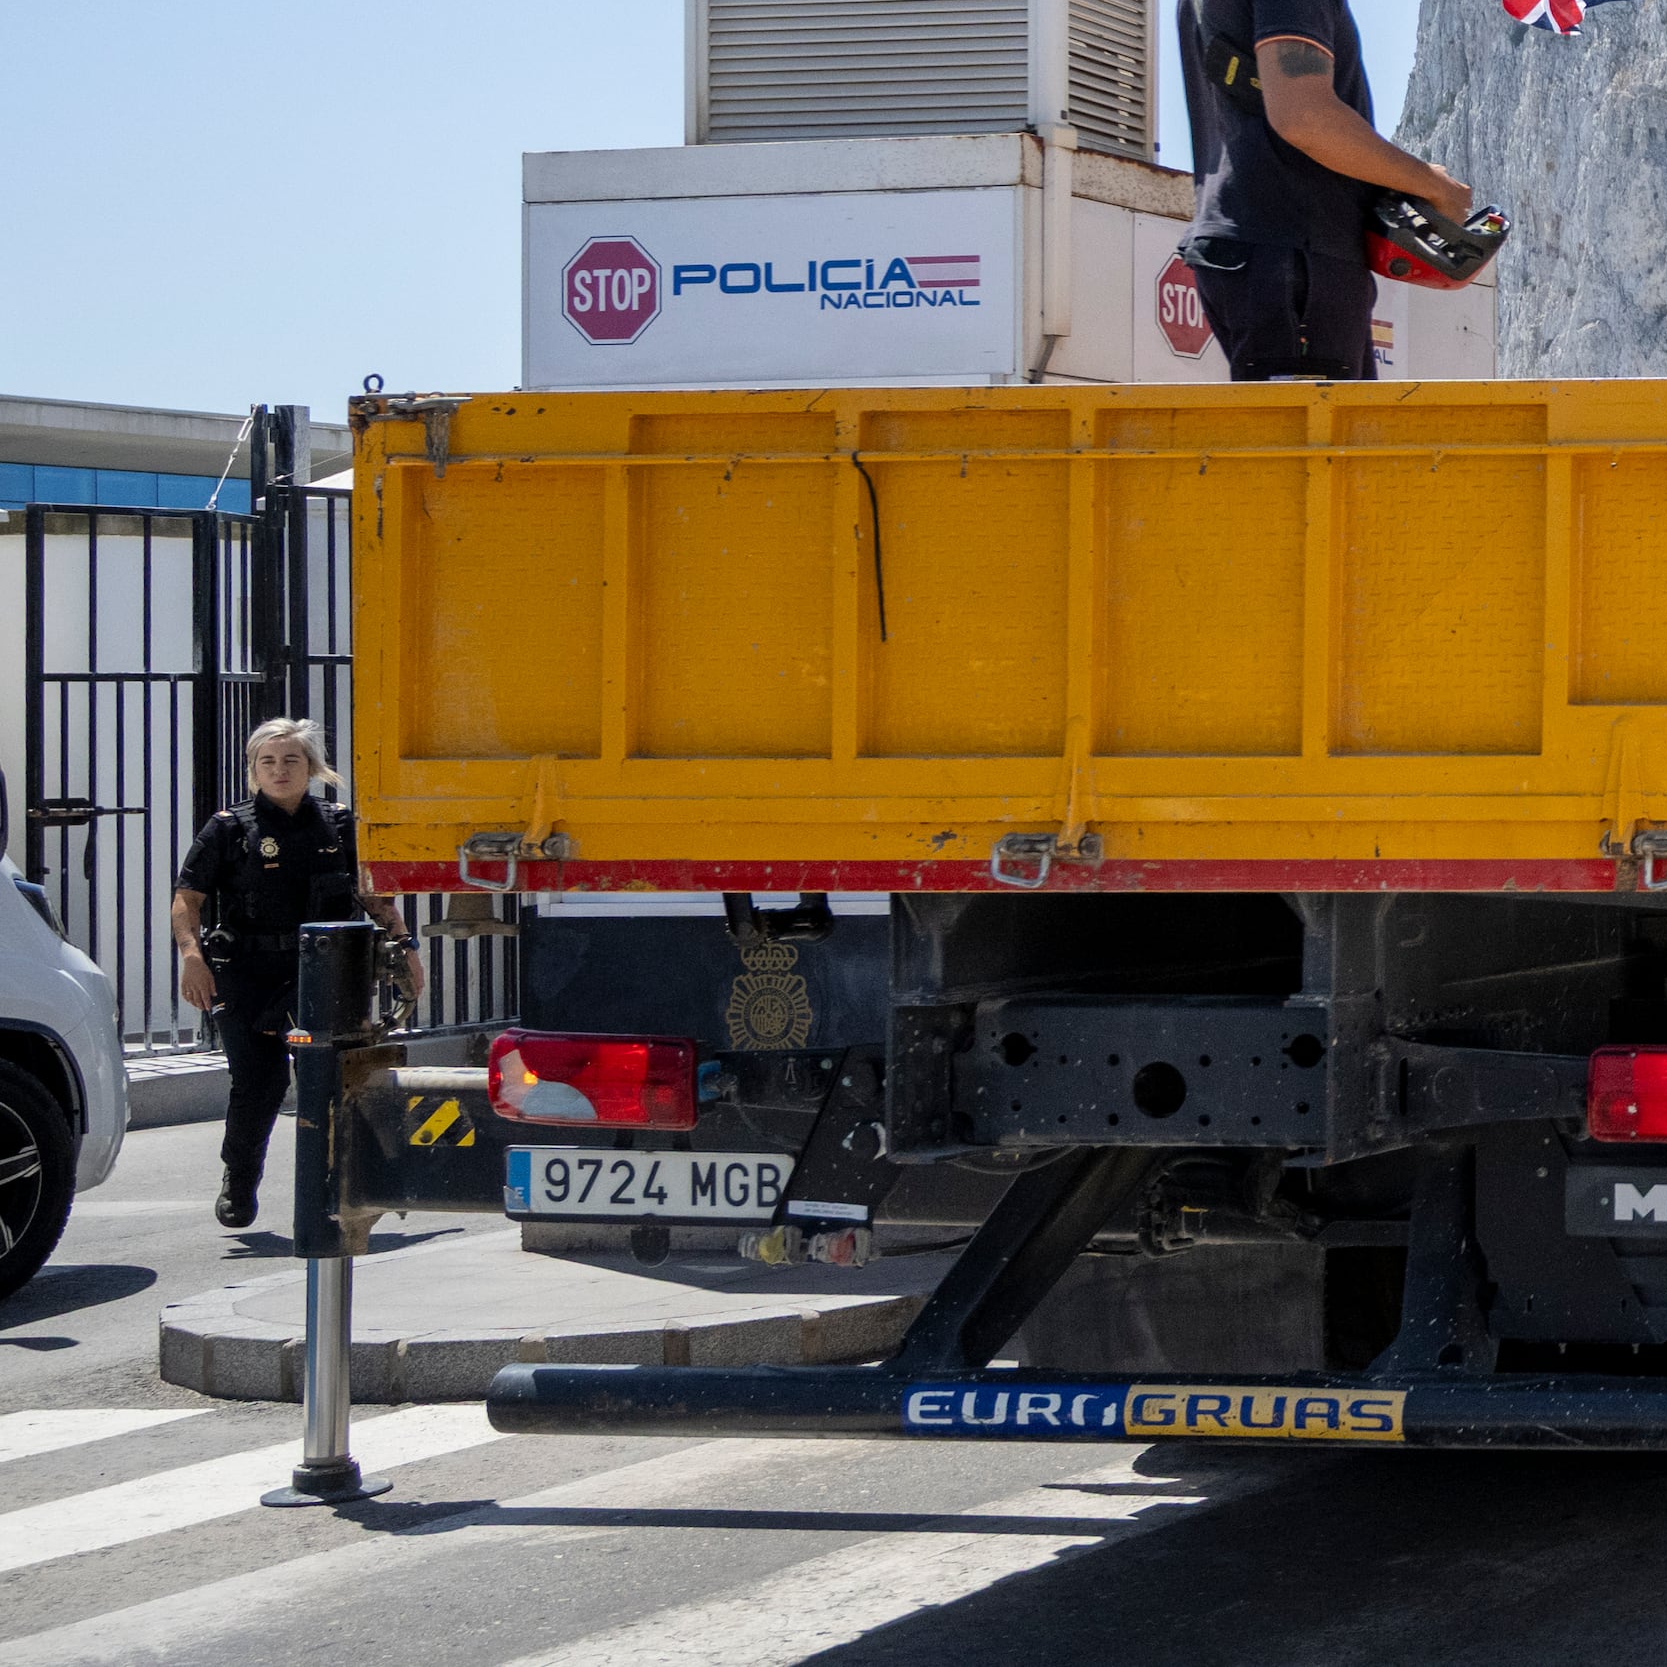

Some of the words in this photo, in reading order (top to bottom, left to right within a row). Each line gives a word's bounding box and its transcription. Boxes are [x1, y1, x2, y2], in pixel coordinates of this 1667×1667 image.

[572, 268, 652, 313] STOP
[820, 289, 981, 311] NACIONAL
[544, 1158, 669, 1207] 9724
[690, 1161, 783, 1208] MGB
